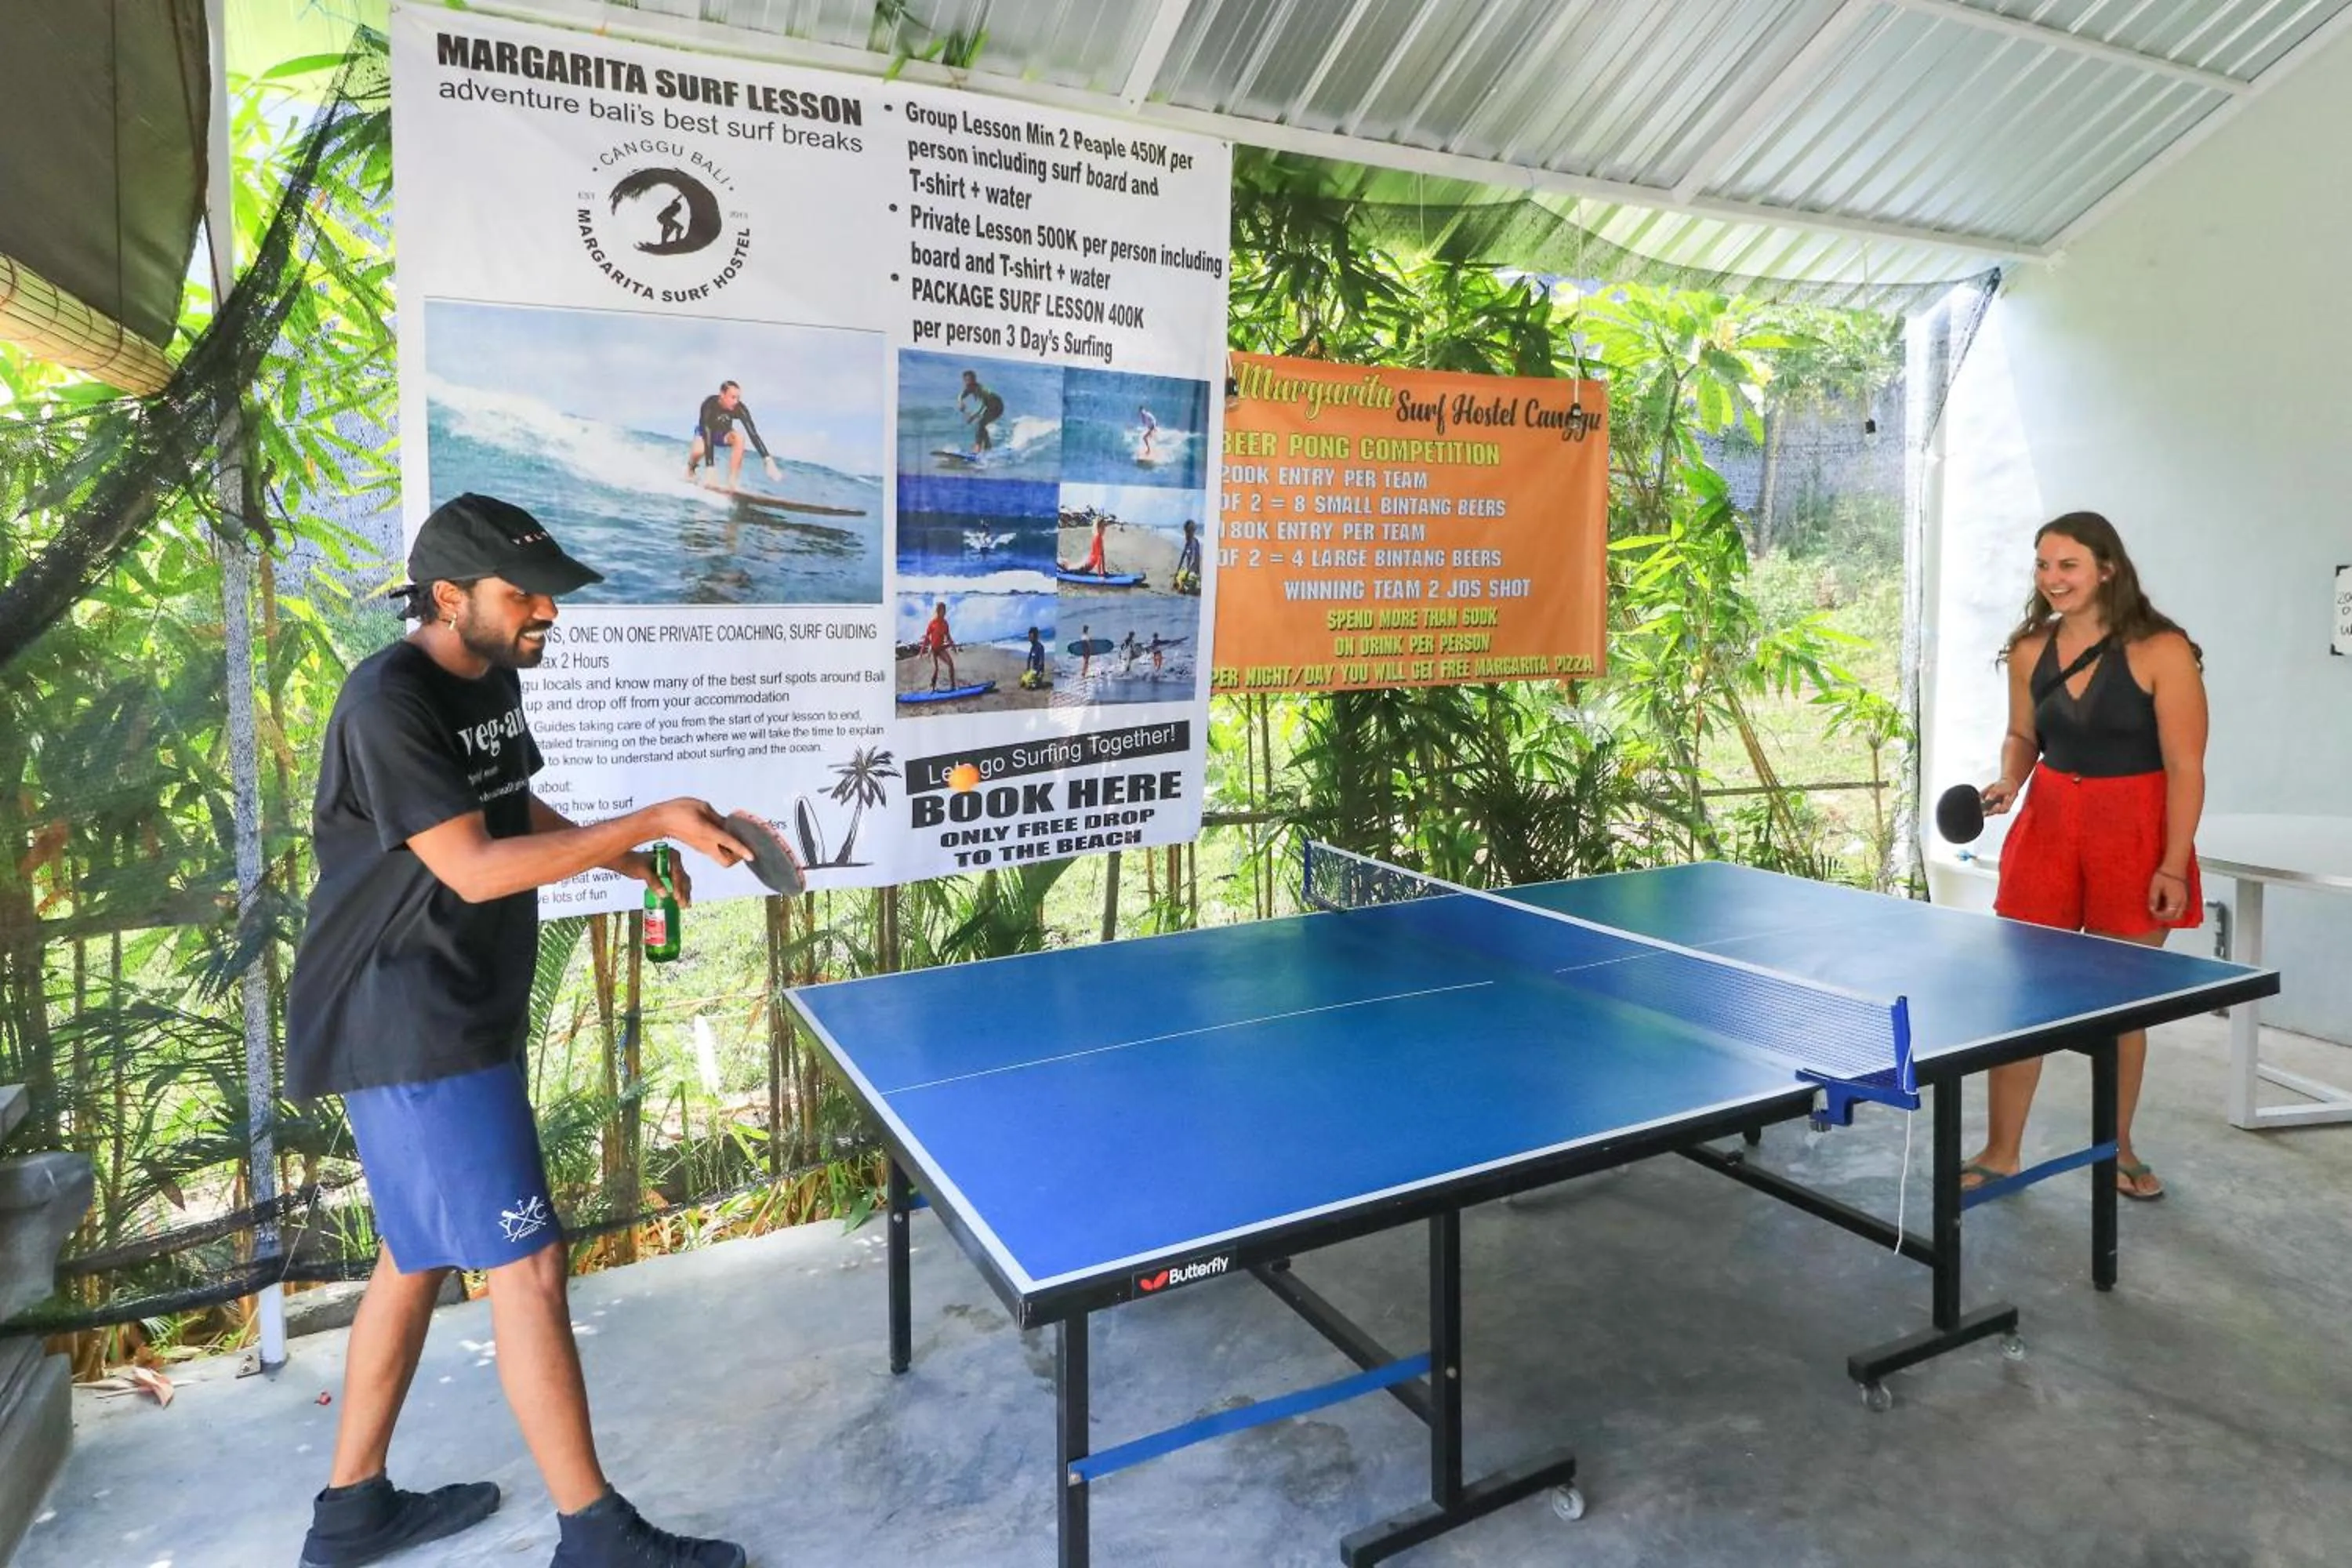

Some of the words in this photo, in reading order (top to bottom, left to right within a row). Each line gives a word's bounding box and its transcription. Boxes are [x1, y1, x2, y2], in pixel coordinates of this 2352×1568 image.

[437, 33, 648, 94] MARGARITA
[655, 69, 739, 107] SURF
[747, 84, 862, 125] LESSON
[440, 78, 579, 114] adventure
[590, 98, 654, 125] bali's
[665, 108, 719, 135] best
[728, 122, 775, 141] surf
[783, 124, 862, 153] breaks
[906, 101, 957, 134] Group
[963, 111, 1021, 142] Lesson
[1026, 122, 1054, 147] Min
[1059, 129, 1069, 148] 2
[1074, 131, 1127, 160] Peaple
[1131, 140, 1167, 166] 450K
[1171, 153, 1193, 172] per
[600, 140, 684, 165] CANGGU
[691, 152, 731, 184] BALI
[908, 140, 968, 161] person
[972, 145, 1047, 183] including
[1052, 162, 1082, 183] surf
[1087, 163, 1127, 192] board
[1132, 177, 1159, 196] and
[909, 169, 965, 198] T-shirt
[971, 182, 980, 198] +
[985, 186, 1032, 210] water
[578, 209, 654, 299] MARGARITA
[662, 285, 710, 302] SURF
[713, 228, 750, 289] HOSTEL
[911, 205, 970, 236] Private
[976, 215, 1033, 245] Lesson
[1037, 224, 1078, 251] 500K
[1083, 235, 1108, 257] per
[1110, 240, 1156, 263] person
[1162, 245, 1222, 279] including
[912, 241, 960, 270] board
[966, 252, 995, 274] and
[1000, 253, 1051, 281] T-shirt
[1058, 264, 1065, 280] +
[1070, 267, 1111, 290] water
[913, 277, 994, 309] PACKAGE
[1000, 289, 1041, 314] SURF
[1046, 295, 1104, 324] LESSON
[1109, 303, 1144, 329] 400K
[913, 319, 942, 343] per
[947, 322, 1001, 346] person
[1007, 324, 1015, 347] 3
[1021, 325, 1058, 357] Day's
[1064, 332, 1112, 364] Surfing
[1232, 362, 1393, 419] Margarita
[1396, 390, 1446, 435] Surf
[1452, 394, 1518, 426] Hostel
[1289, 433, 1350, 459] PONG
[1360, 436, 1500, 466] COMPETITION
[1279, 466, 1334, 486] ENTRY
[1345, 469, 1377, 488] PER
[1384, 470, 1428, 489] TEAM
[1251, 493, 1261, 512] 2
[1271, 499, 1285, 507] =
[1294, 495, 1305, 512] 8
[1316, 495, 1372, 514] SMALL
[1381, 496, 1451, 515] BINTANG
[1457, 499, 1506, 517] BEERS
[1277, 521, 1333, 540] ENTRY
[1343, 523, 1374, 540] PER
[1382, 523, 1425, 541] TEAM
[1249, 550, 1261, 567] 2
[1270, 554, 1283, 562] =
[1292, 550, 1304, 567] 4
[1312, 550, 1367, 567] LARGE
[1375, 550, 1445, 567] BINTANG
[1452, 550, 1502, 567] BEERS
[1284, 580, 1365, 601] WINNING
[1374, 580, 1421, 600] TEAM
[1428, 579, 1439, 598] 2
[1447, 579, 1481, 598] JOS
[1490, 579, 1530, 597] SHOT
[569, 626, 599, 643] ONE
[603, 626, 622, 642] ON
[627, 626, 655, 642] ONE
[659, 626, 713, 641] PRIVATE
[790, 623, 822, 640] SURF
[826, 623, 877, 640] GUIDING
[1328, 609, 1374, 630] SPEND
[1380, 608, 1418, 629] MORE
[1424, 608, 1458, 628] THAN
[539, 655, 557, 668] ax
[561, 652, 568, 668] 2
[573, 652, 609, 668] Hours
[1361, 635, 1403, 656] DRINK
[1410, 634, 1434, 655] PER
[1440, 633, 1491, 654] PERSON
[543, 678, 582, 690] locals
[586, 677, 610, 689] and
[615, 677, 650, 689] know
[654, 677, 688, 689] many
[692, 674, 703, 687] of
[708, 673, 727, 685] the
[731, 673, 756, 685] best
[760, 672, 782, 684] surf
[785, 672, 816, 685] spots
[820, 671, 861, 682] around
[1211, 667, 1239, 688] PER
[1342, 663, 1368, 684] YOU
[1374, 662, 1406, 683] WILL
[1412, 661, 1435, 681] GET
[1441, 660, 1470, 678] FREE
[1475, 657, 1548, 677] MARGARITA
[1554, 654, 1594, 673] PIZZA
[525, 701, 543, 713] up
[547, 698, 572, 710] and
[576, 698, 606, 711] drop
[610, 696, 627, 710] off
[631, 696, 659, 708] from
[663, 697, 691, 710] your
[694, 690, 789, 706] accommodation
[980, 756, 1004, 780] go
[1013, 744, 1081, 769] Surfing
[1087, 724, 1176, 756] Together!
[572, 800, 594, 811] how
[599, 800, 608, 809] to
[612, 797, 633, 809] surf
[912, 782, 1054, 829] BOOK
[1069, 771, 1181, 810] HERE
[941, 826, 1011, 848] ONLY
[1018, 817, 1078, 837] FREE
[1085, 809, 1154, 829] DROP
[954, 851, 991, 868] TO
[999, 844, 1050, 862] THE
[1057, 830, 1142, 854] BEACH
[554, 891, 572, 903] lots
[575, 890, 585, 902] of
[590, 889, 607, 900] fun
[1170, 1257, 1229, 1284] Butterfly
